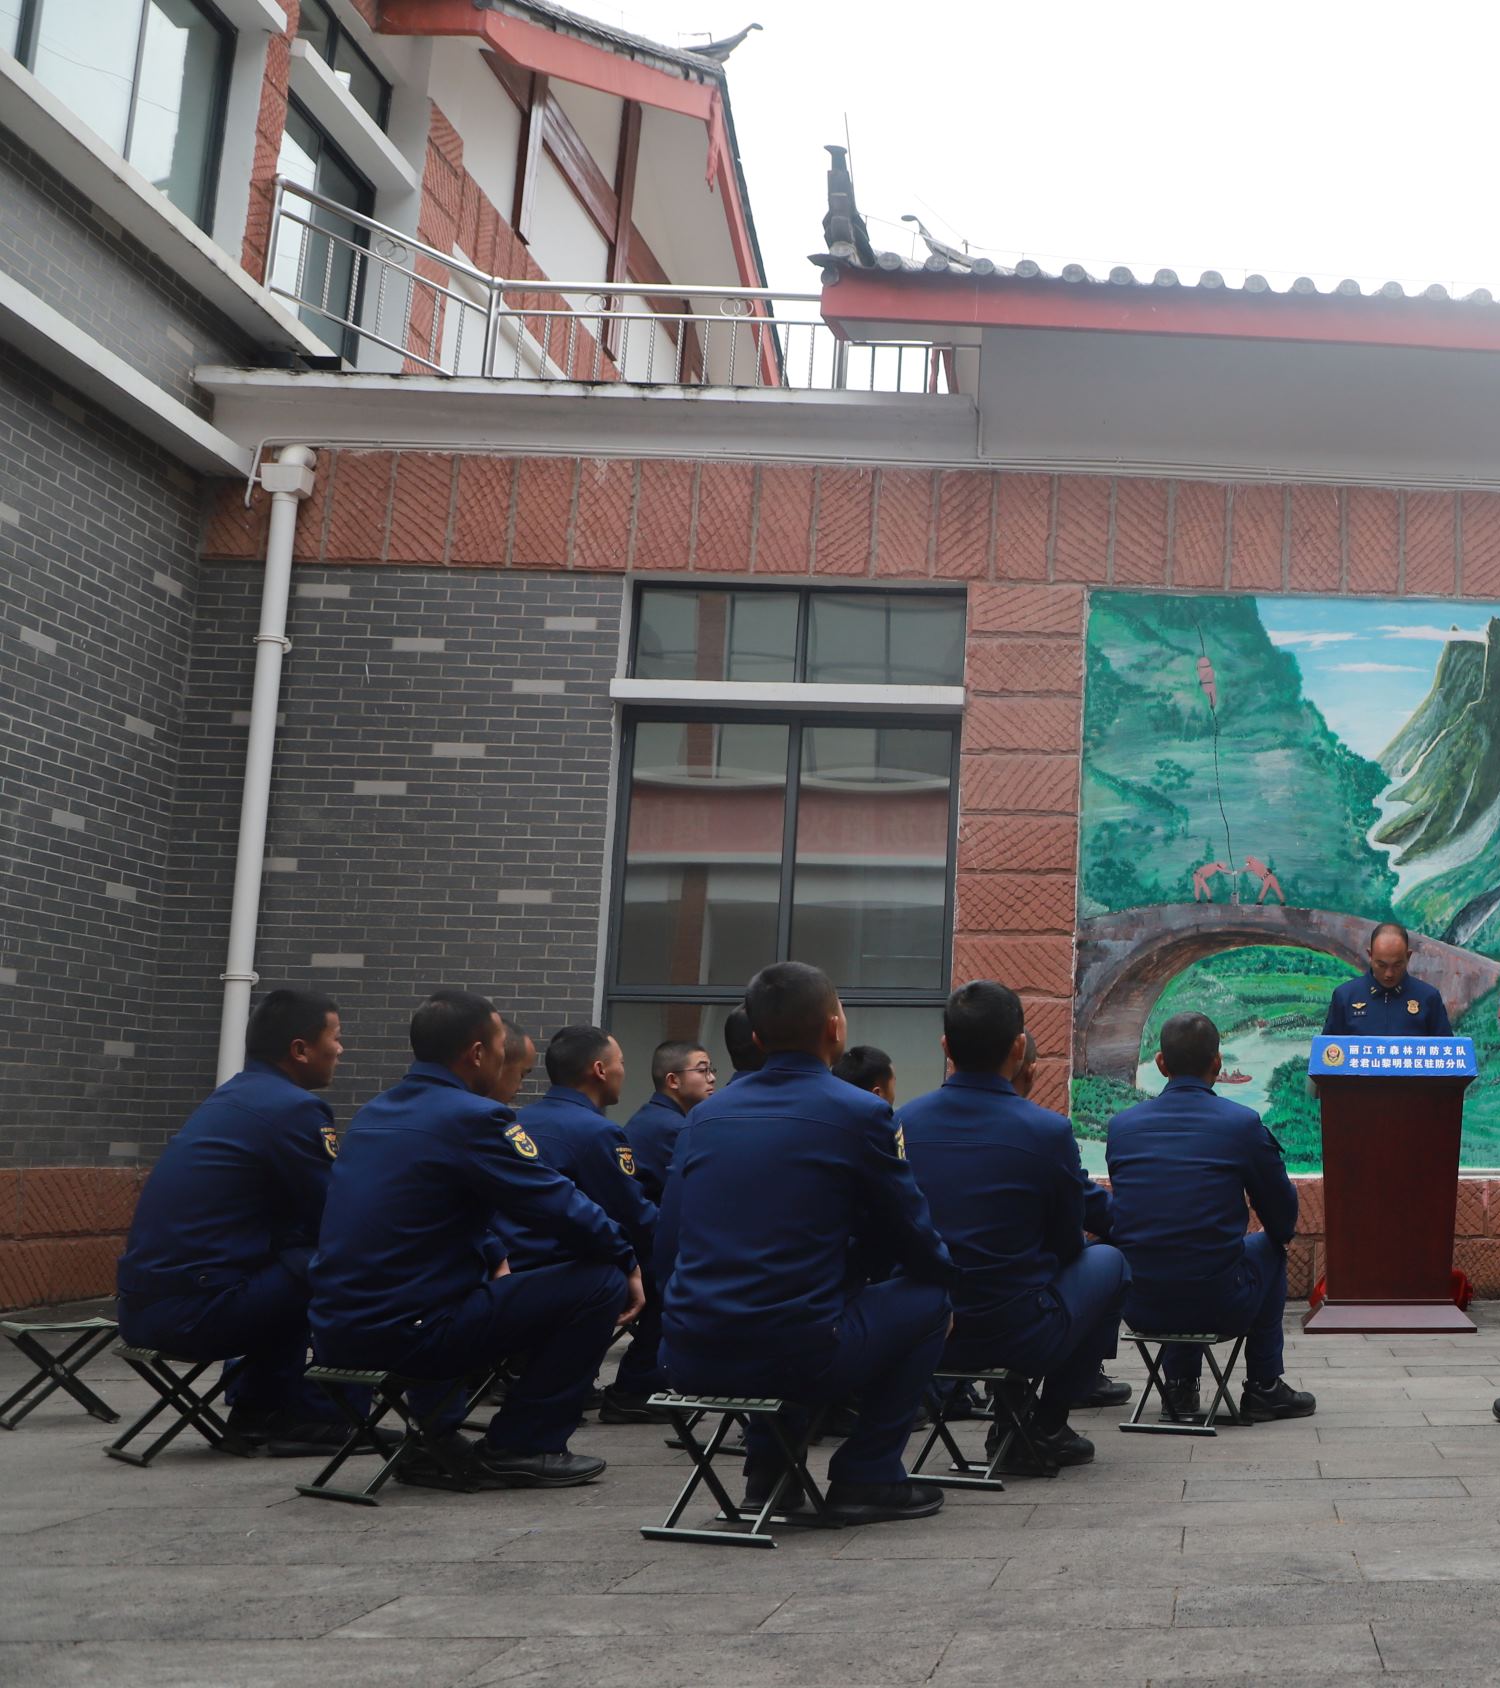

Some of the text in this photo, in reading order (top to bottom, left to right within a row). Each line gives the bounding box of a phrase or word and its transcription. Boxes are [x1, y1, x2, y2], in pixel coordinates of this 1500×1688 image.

[1349, 1045, 1466, 1056] 丽江市森林消防支队
[1349, 1058, 1466, 1069] 老君山黎明景区驻防分队
